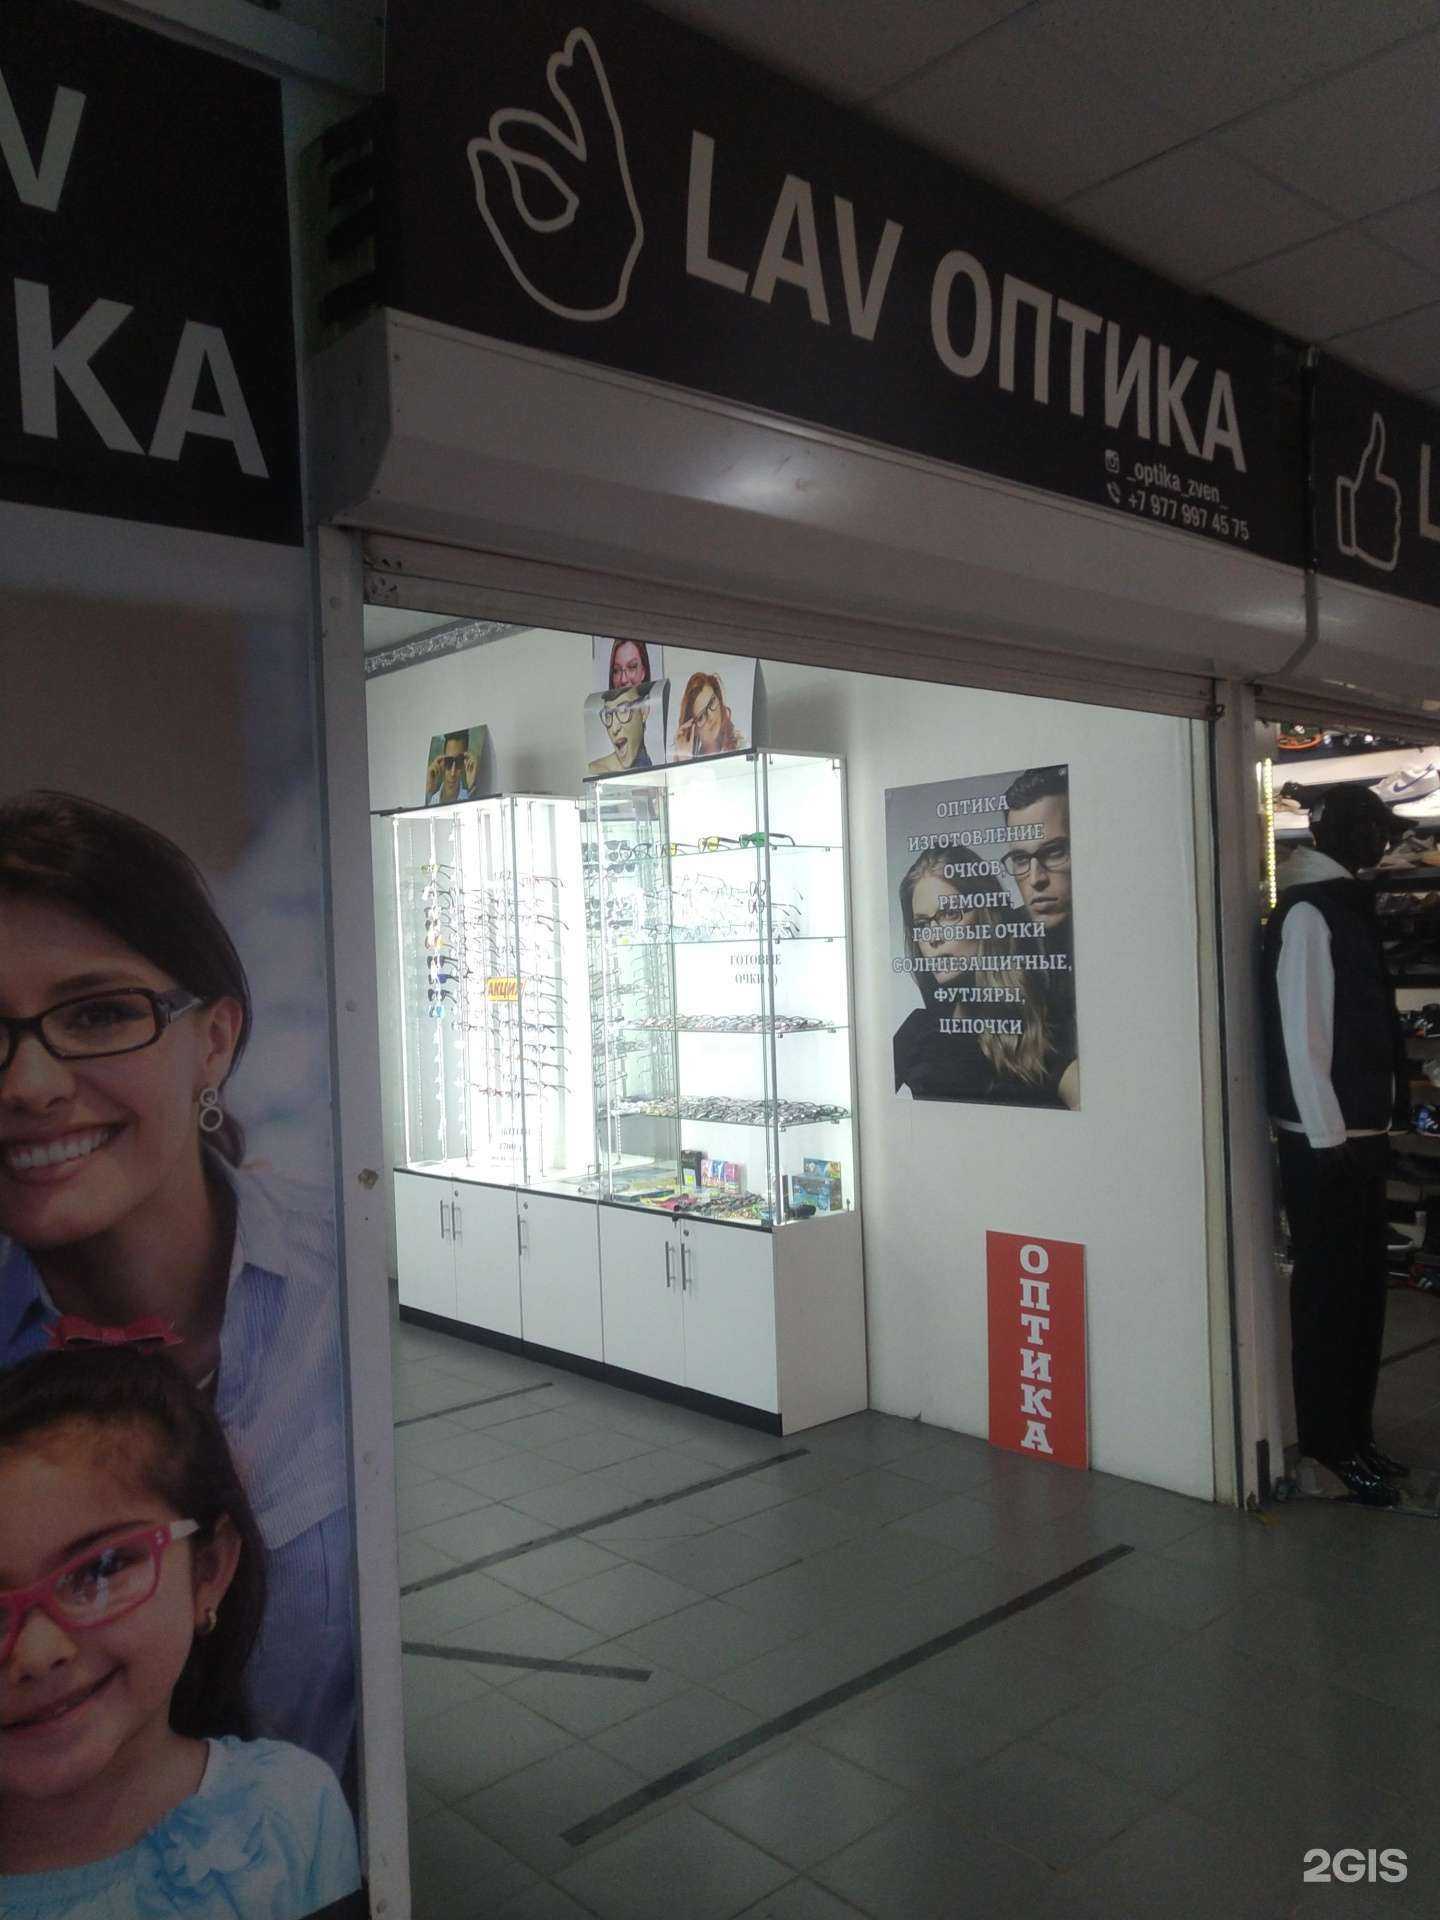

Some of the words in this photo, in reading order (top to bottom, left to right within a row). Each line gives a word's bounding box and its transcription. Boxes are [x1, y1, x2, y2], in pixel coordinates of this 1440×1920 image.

[685, 129, 905, 343] LAV
[929, 248, 1248, 474] ОПТИКА
[13, 277, 271, 480] КА
[1127, 489, 1146, 511] +7
[1149, 494, 1178, 521] 977
[1180, 502, 1208, 529] 997
[1211, 511, 1230, 536] 45
[1231, 518, 1249, 541] 75
[935, 794, 1010, 818] ОПТИКА
[911, 923, 992, 943] ГОТОВЫЕ
[994, 920, 1046, 939] ОЧКИ
[892, 953, 1073, 974] СОЛНЦЕЗАЩИТНЫЕ,
[933, 987, 1025, 1006] ФУТЛЯРЫ,
[938, 1018, 1023, 1035] ЦЕПОЧКИ
[1018, 1243, 1054, 1456] ОПТИКА
